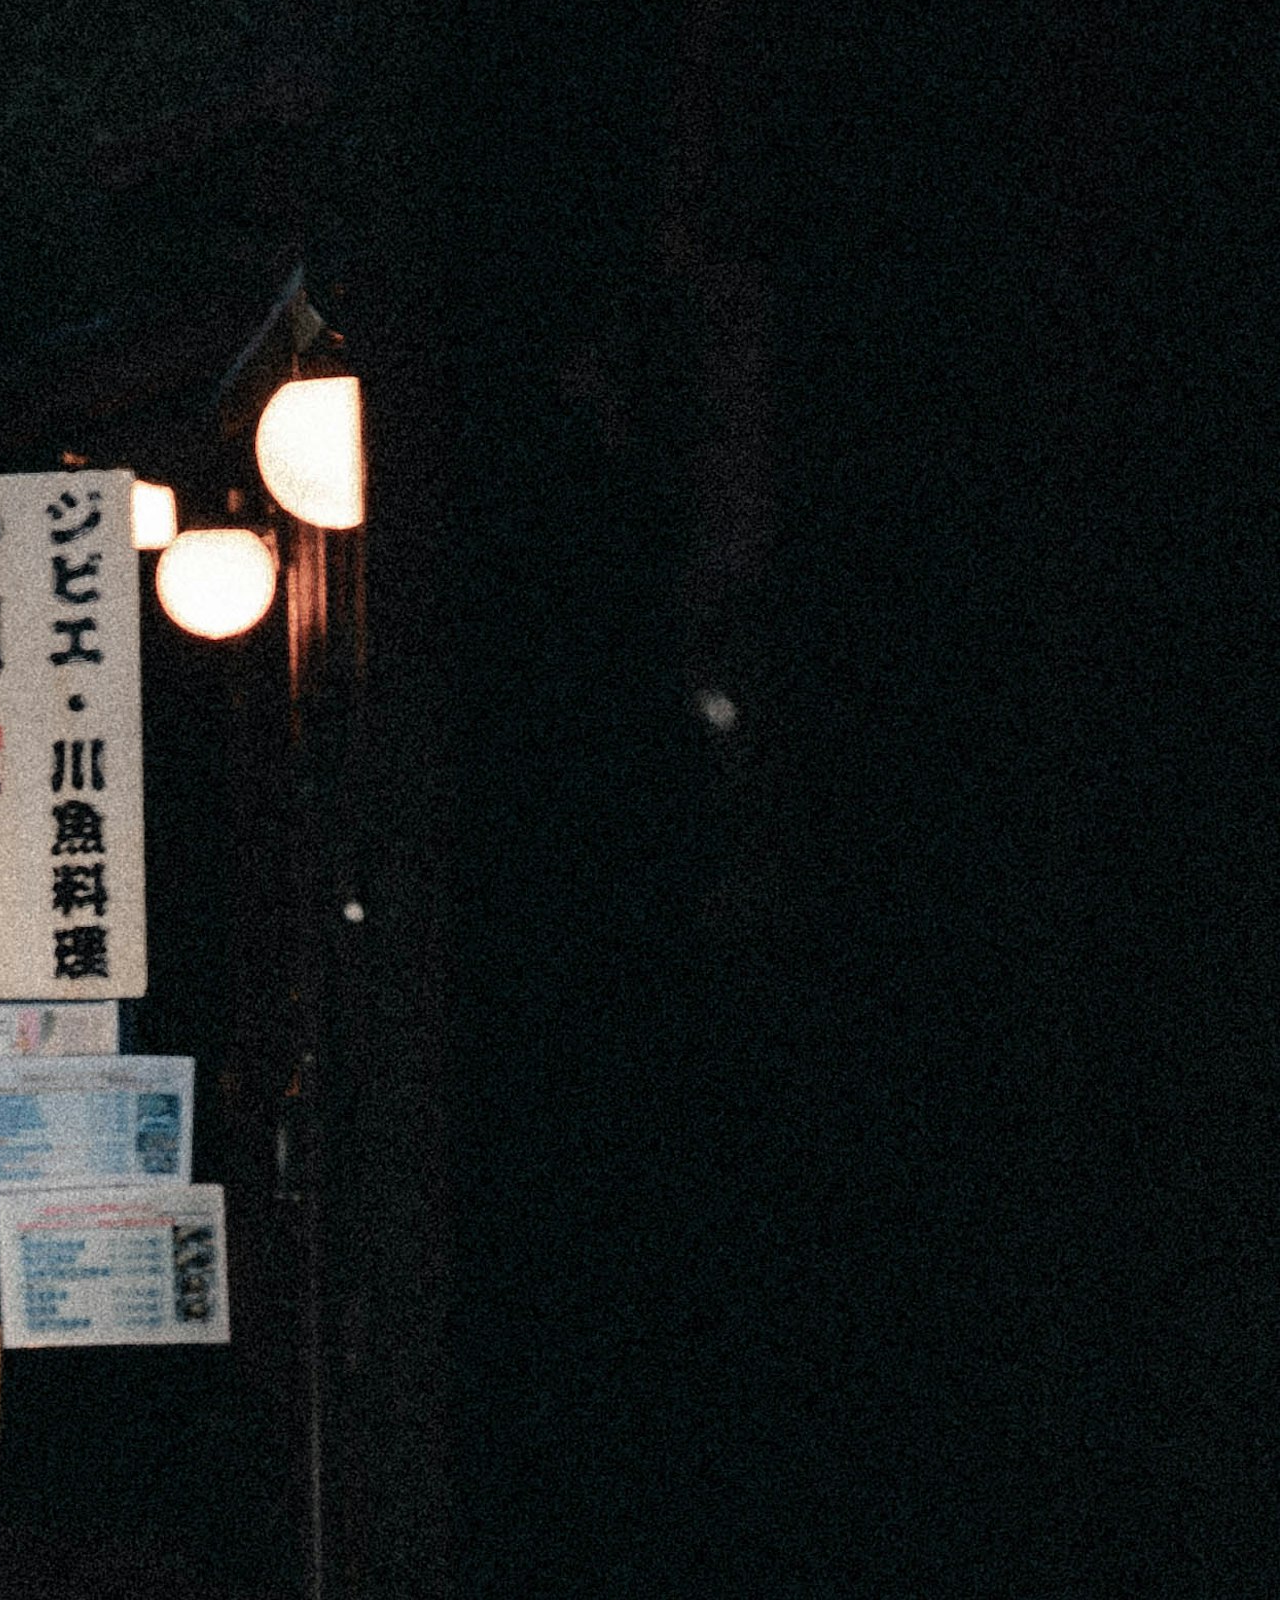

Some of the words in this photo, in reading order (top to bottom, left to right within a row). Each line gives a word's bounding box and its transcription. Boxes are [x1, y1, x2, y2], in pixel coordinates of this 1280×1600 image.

[46, 491, 109, 980] ジビエ・川魚料理
